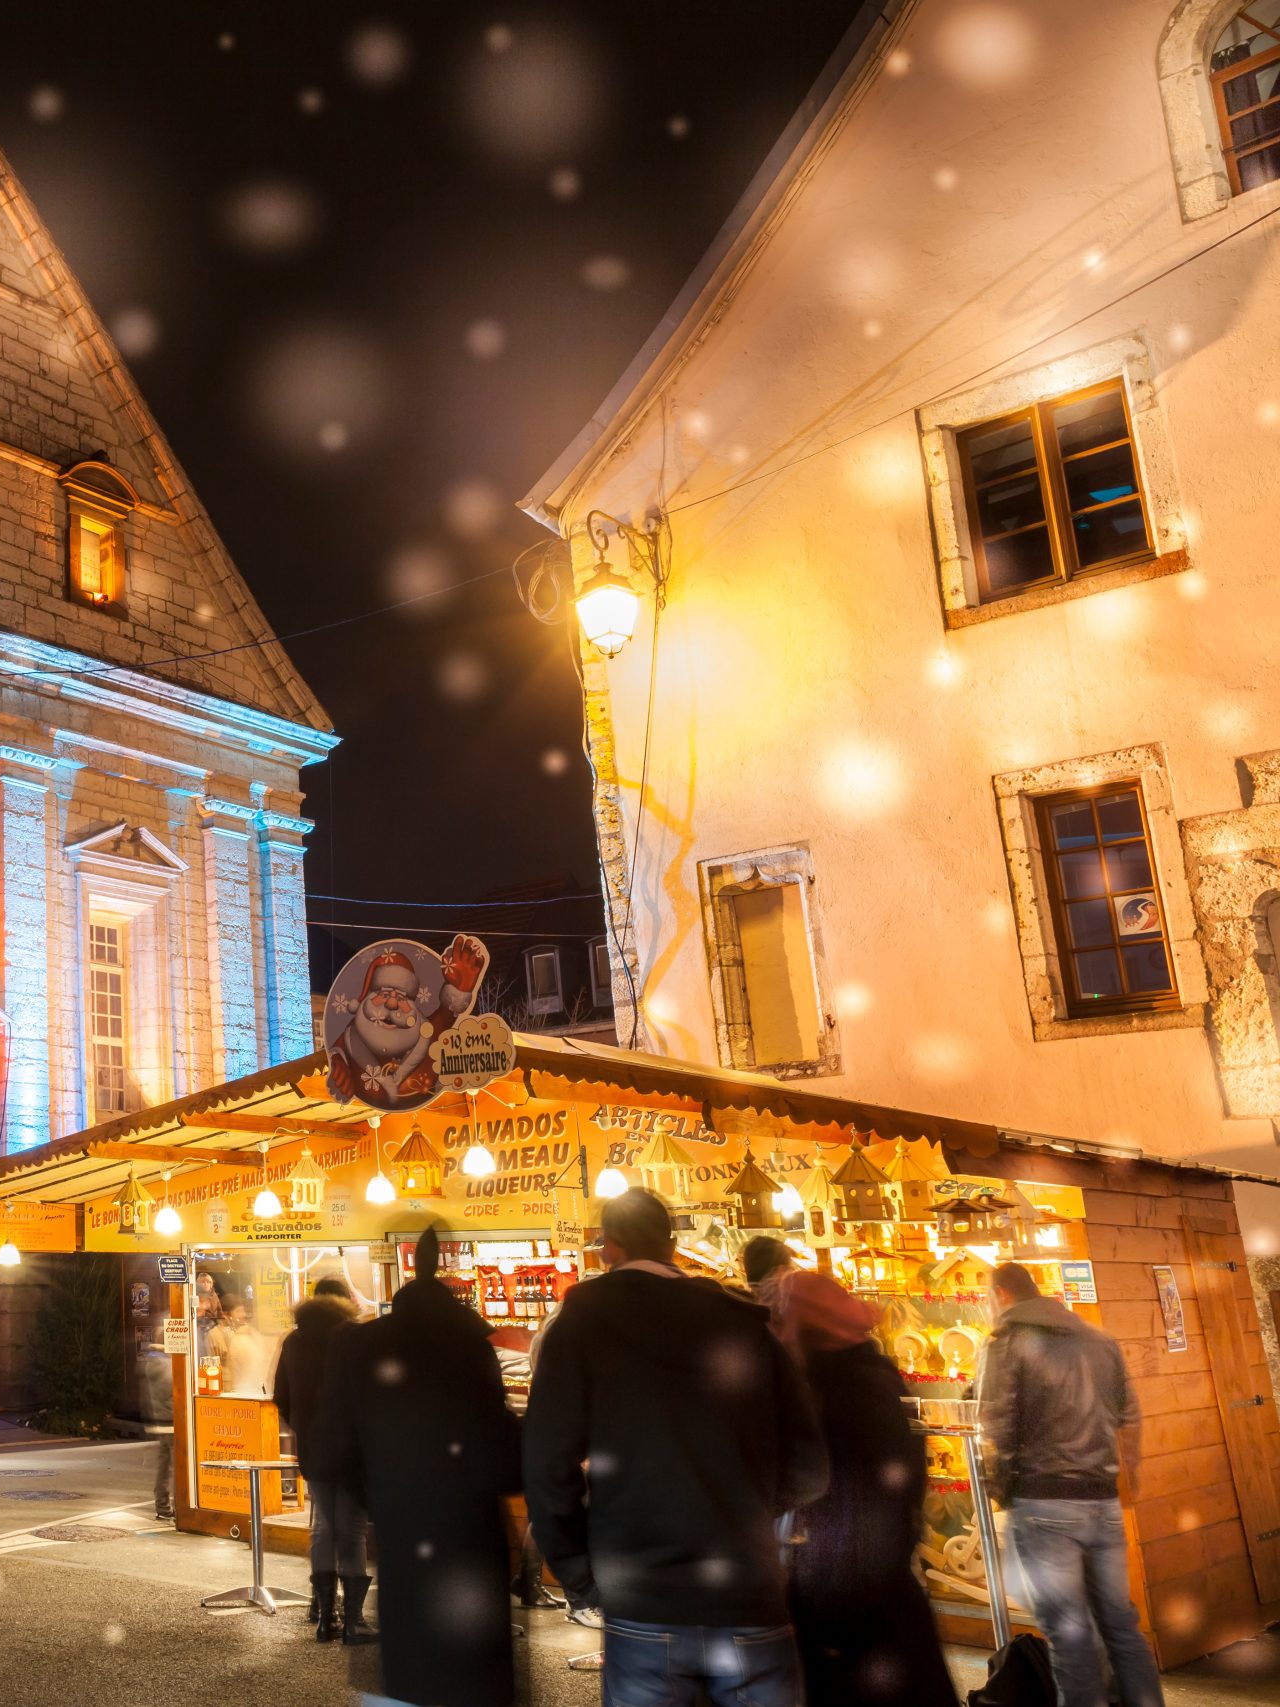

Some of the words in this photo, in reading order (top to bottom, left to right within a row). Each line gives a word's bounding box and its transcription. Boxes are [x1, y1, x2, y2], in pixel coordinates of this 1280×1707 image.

[449, 1035, 462, 1052] 10
[440, 1045, 508, 1076] Anniversaire
[443, 1110, 568, 1150] CALVADOS
[589, 1104, 727, 1146] ARTICLES
[442, 1142, 571, 1178] PMEAU
[185, 1186, 207, 1206] DANS
[210, 1182, 221, 1198] LE
[242, 1168, 265, 1190] MAIS
[466, 1172, 558, 1199] LIQUEURS
[463, 1203, 499, 1217] CIDRE
[231, 1223, 249, 1233] au
